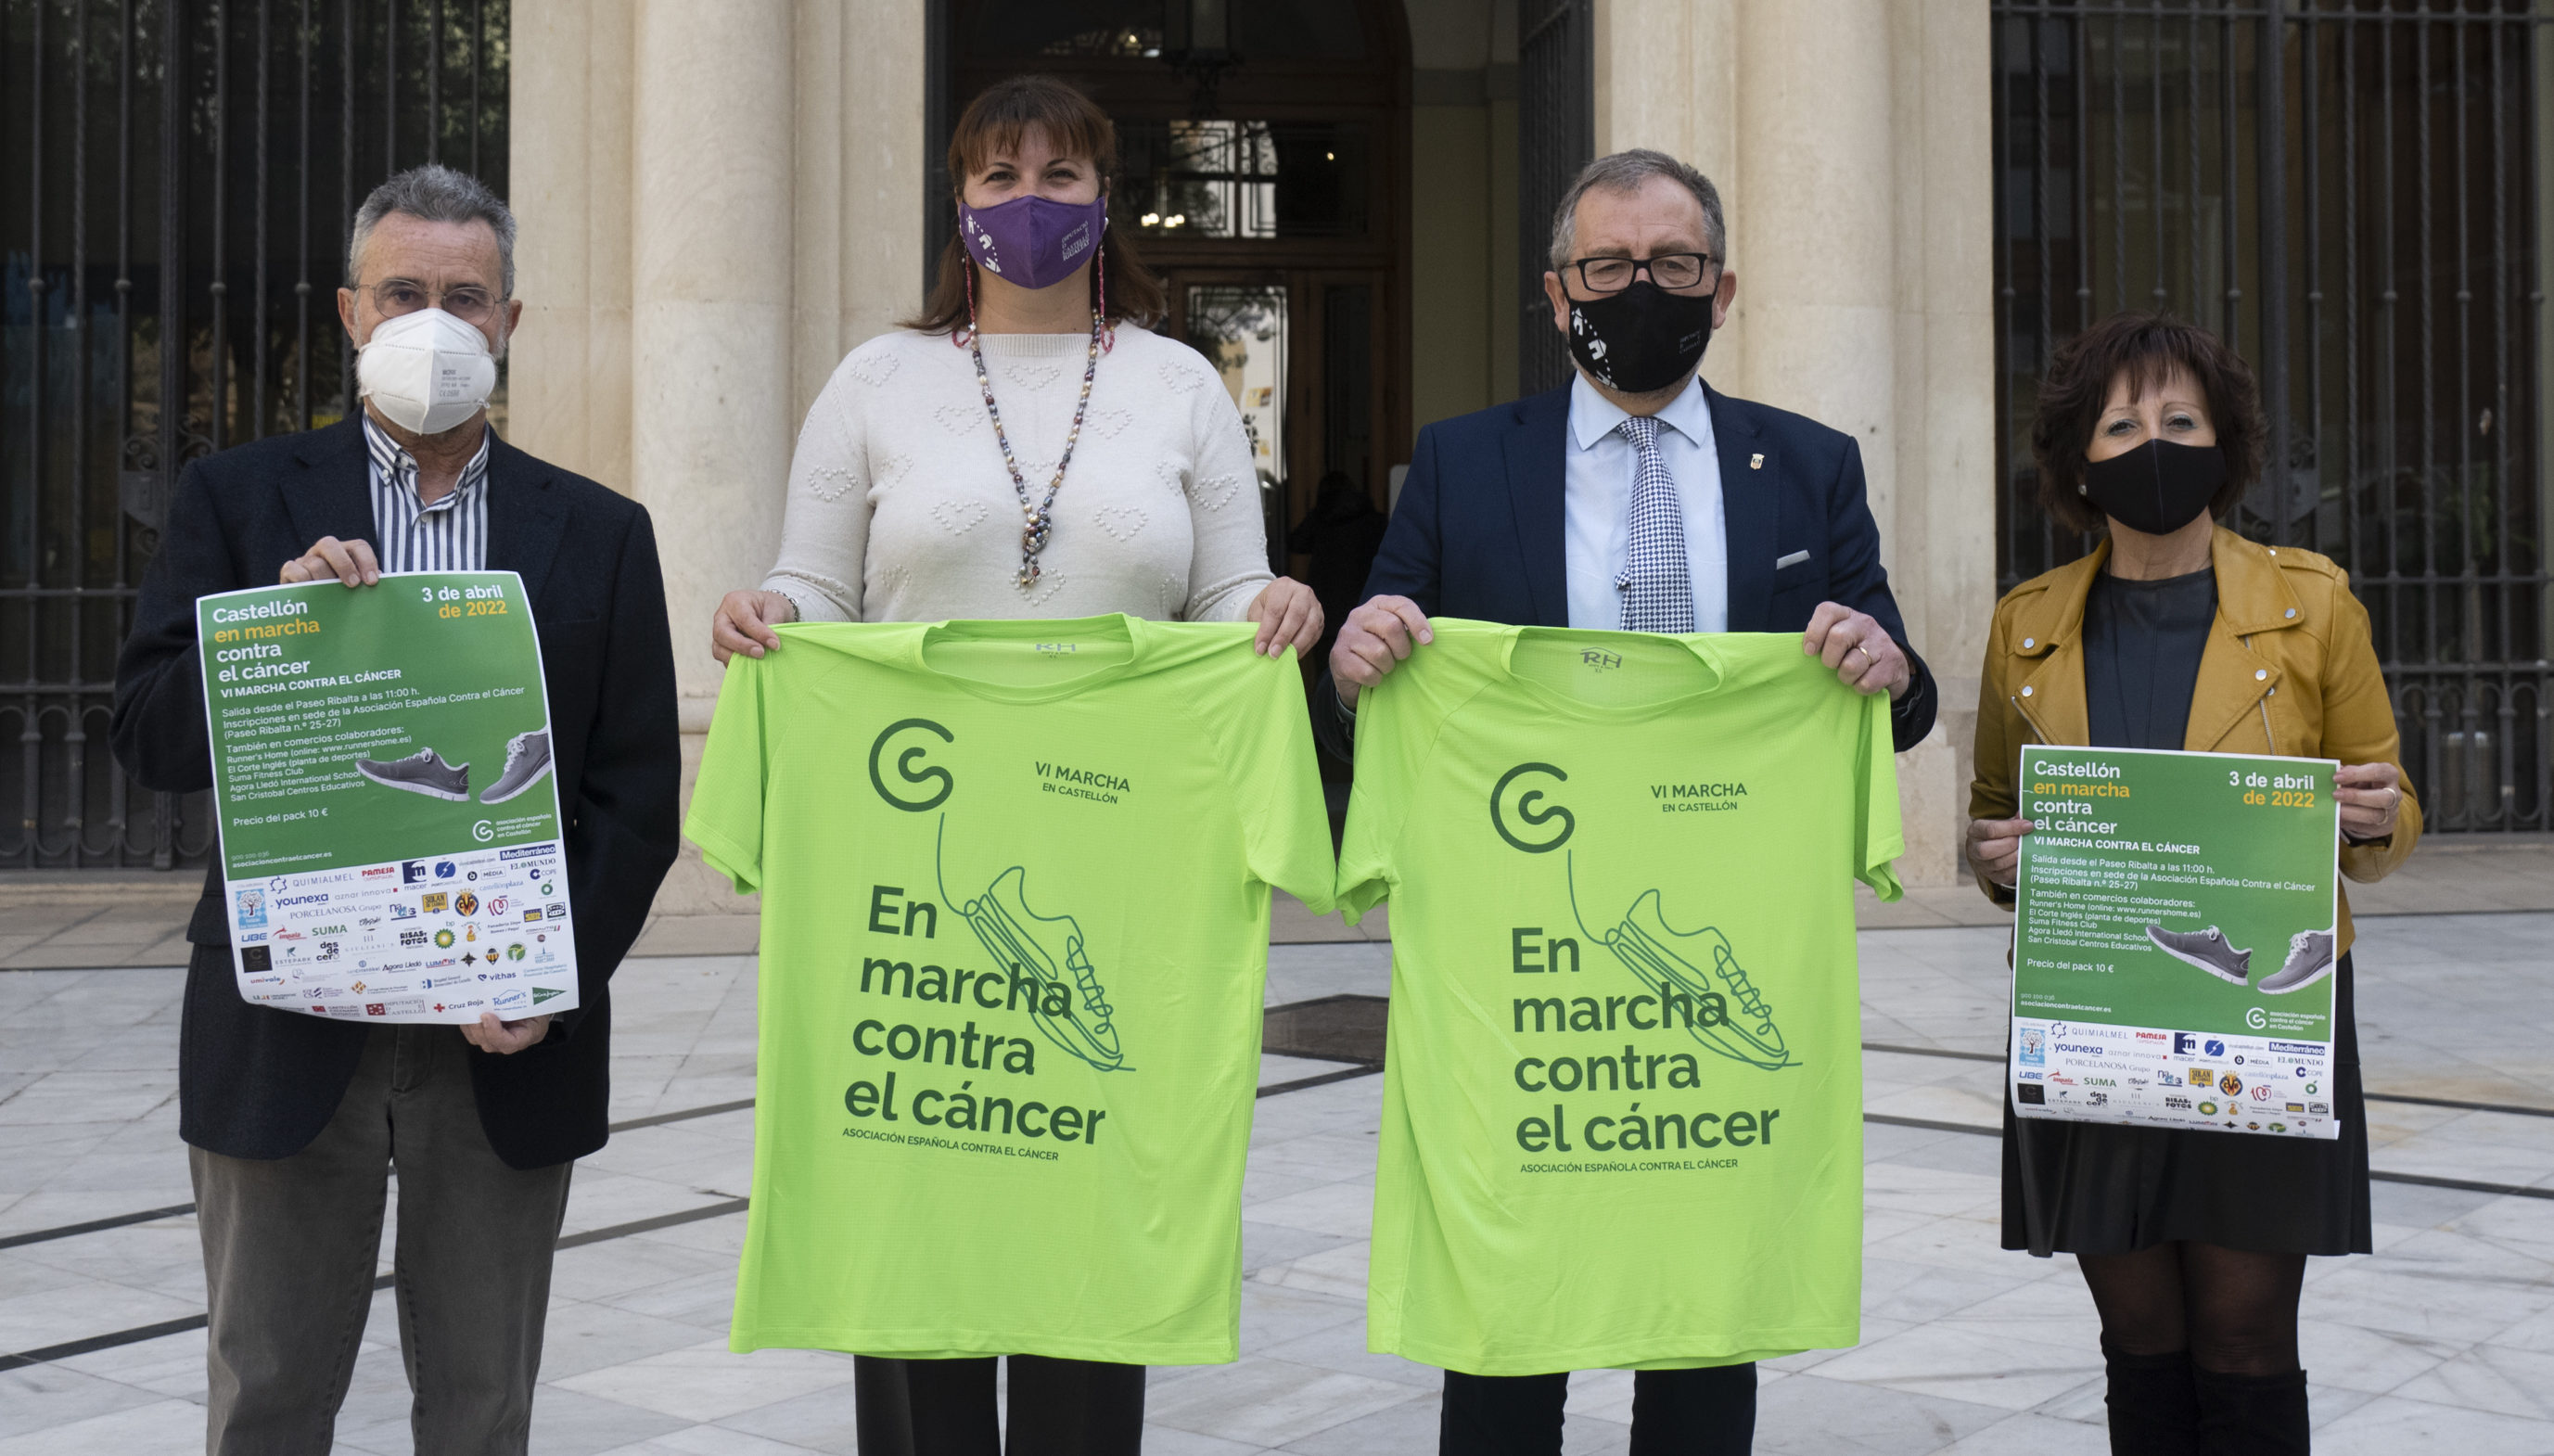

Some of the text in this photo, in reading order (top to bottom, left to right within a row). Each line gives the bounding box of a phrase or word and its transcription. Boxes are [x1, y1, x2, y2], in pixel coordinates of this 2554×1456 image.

[421, 583, 504, 602] 3 de abril
[212, 601, 307, 623] Castellón
[438, 599, 507, 619] de 2022
[213, 618, 320, 643] en marcha
[215, 643, 282, 662] contra
[218, 660, 311, 683] el cáncer
[220, 669, 402, 698] VI MARCHA CONTRA EL CÁNCER
[222, 707, 251, 718] Salida
[252, 703, 283, 714] desde
[284, 701, 294, 710] el
[295, 698, 326, 709] Paseo
[326, 694, 359, 705] Ribalta
[369, 692, 383, 700] las
[385, 687, 409, 698] 11:00
[410, 686, 419, 696] h.
[223, 686, 525, 729] Inscripciones en sede de la Asociación Española Contra el Cáncer
[223, 717, 341, 740] (Paseo Ribalta n.º 25-27)
[224, 726, 404, 753] También en comercios colaboradores:
[225, 734, 412, 763] Runner's Home (online: www.runnershome.es)
[226, 749, 370, 773] El Corte Inglés (planta de deportes)
[2034, 760, 2120, 778] Castellón
[227, 766, 304, 783] Suma Fitness Club
[229, 770, 361, 793] Agora Lledó International School
[1035, 760, 1130, 792] VI MARCHA
[2228, 771, 2314, 790] 3 de abril
[230, 780, 365, 802] San Cristobal Centros Educativos
[1041, 782, 1117, 804] EN CASTELLÓN
[1651, 782, 1747, 798] VI MARCHA
[2034, 781, 2130, 798] en marcha
[2242, 790, 2315, 808] de 2022
[1662, 799, 1737, 812] EN CASTELLÓN
[2033, 799, 2092, 815] contra
[233, 807, 328, 826] Precio del pack 10 €
[2034, 815, 2117, 834] el cáncer
[502, 845, 555, 860] Mediterráneo
[2033, 836, 2200, 854] VI MARCHA CONTRA EL CÁNCER
[2031, 853, 2058, 864] Salida
[2059, 856, 2088, 866] desde
[2088, 858, 2097, 866] el
[2099, 858, 2126, 868] Paseo
[2127, 860, 2158, 870] Ribalta
[2167, 862, 2180, 872] las
[2182, 863, 2204, 874] 11:00
[2206, 865, 2215, 874] h.
[293, 874, 354, 888] QUIMIALMEL
[275, 893, 328, 909] younexa
[290, 903, 381, 919] PORCELANOSA Grupo
[868, 884, 937, 939] En
[241, 932, 267, 942] UBE
[312, 925, 347, 937] SUMA
[1512, 926, 1580, 973] En
[2026, 957, 2113, 973] Precio del pack 10 €
[490, 972, 517, 981] vithas
[861, 956, 1071, 1020] marcha
[467, 999, 484, 1007] Roja
[1513, 981, 1730, 1032] marcha
[2072, 1028, 2128, 1039] QUIMIALMEL
[852, 1018, 1035, 1076] contra
[2054, 1042, 2103, 1054] younexa
[2271, 1043, 2325, 1055] Mediterráneo
[1513, 1044, 1701, 1092] contra
[2084, 1078, 2116, 1087] SUMA
[844, 1073, 1105, 1144] el cáncer
[1515, 1103, 1780, 1153] el cáncer
[842, 1127, 1059, 1160] ASOCIACIÓN ESPAÑOLA CONTRA EL CÁNCER
[1520, 1157, 1738, 1172] ASOCIACIÓN ESPAÑOLA CONTRA EL CÁNCER
